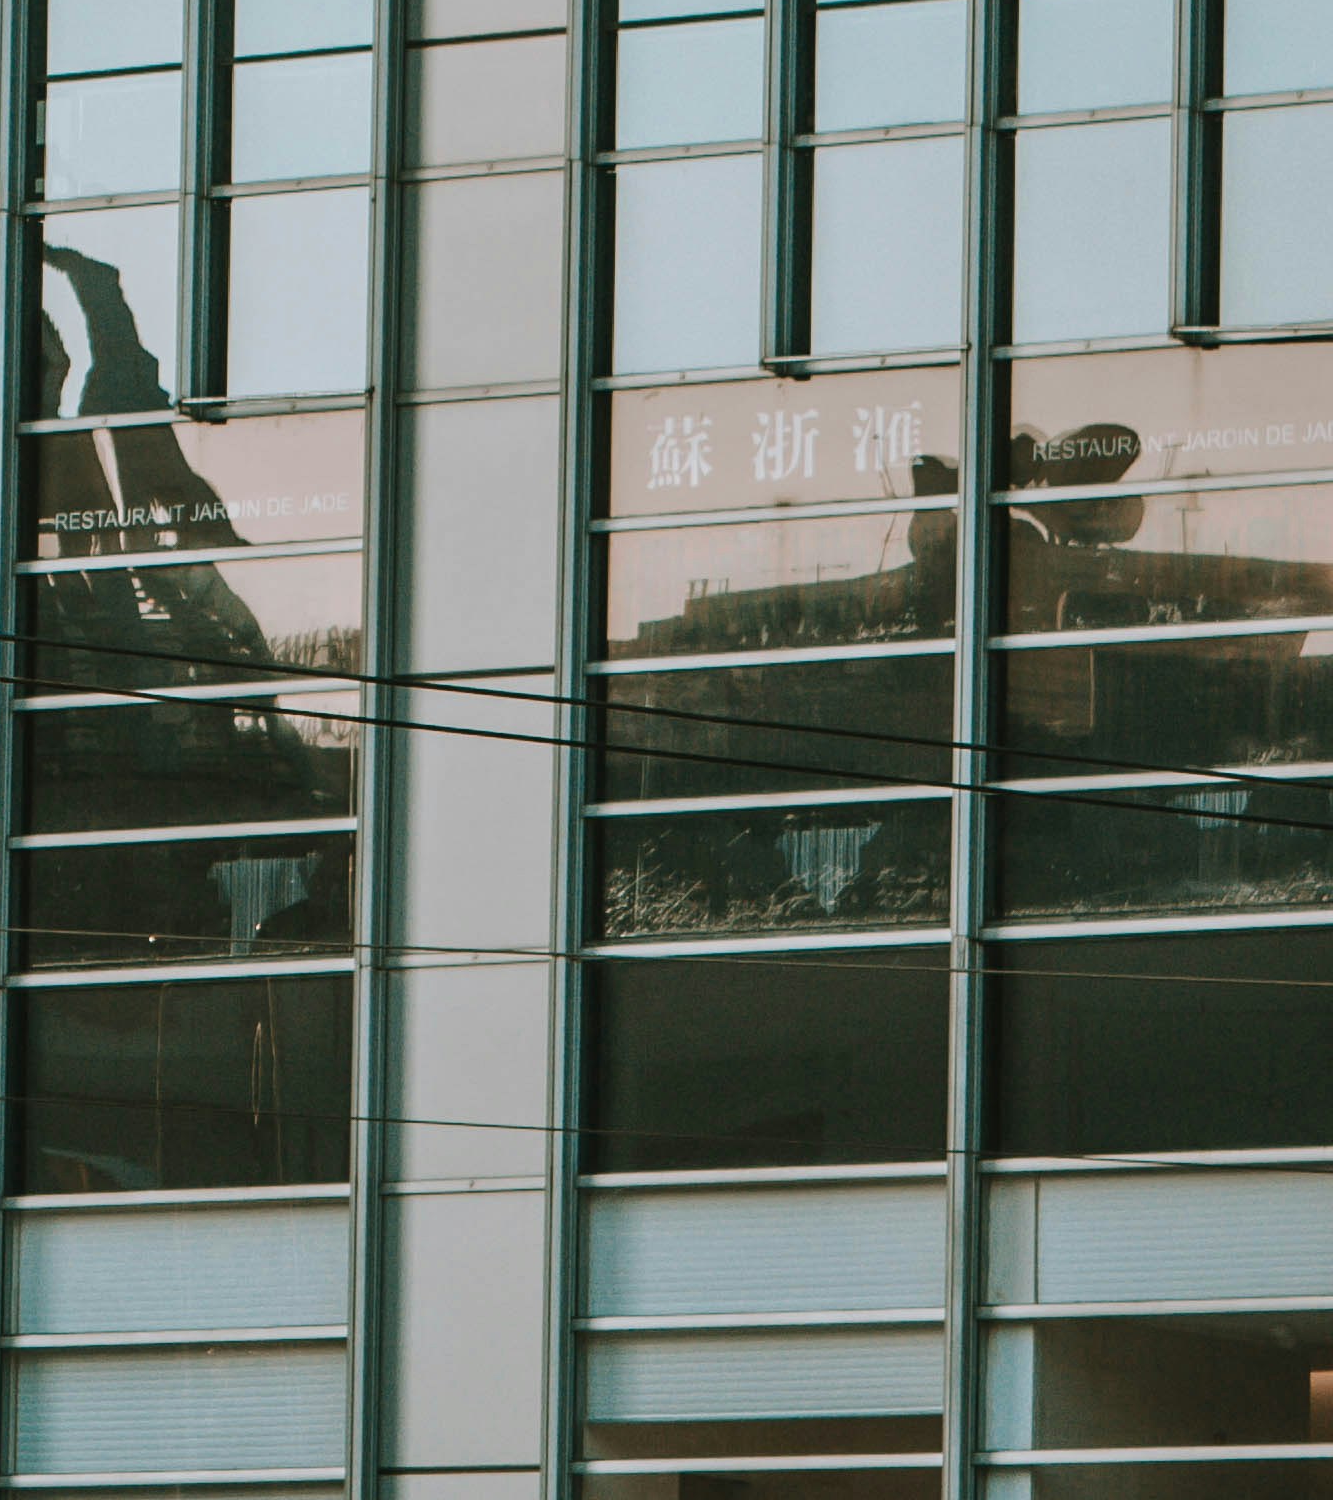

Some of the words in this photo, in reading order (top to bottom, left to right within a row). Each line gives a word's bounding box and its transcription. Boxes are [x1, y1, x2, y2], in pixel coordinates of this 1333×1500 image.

[1032, 434, 1174, 461] RESTAURANT
[1181, 429, 1259, 452] JARDIN
[1265, 423, 1293, 445] DE
[1302, 418, 1333, 442] JA
[54, 504, 185, 532] RESTAURANT
[190, 499, 260, 522] JARDIN
[265, 498, 294, 517] DE
[300, 493, 350, 515] JADE
